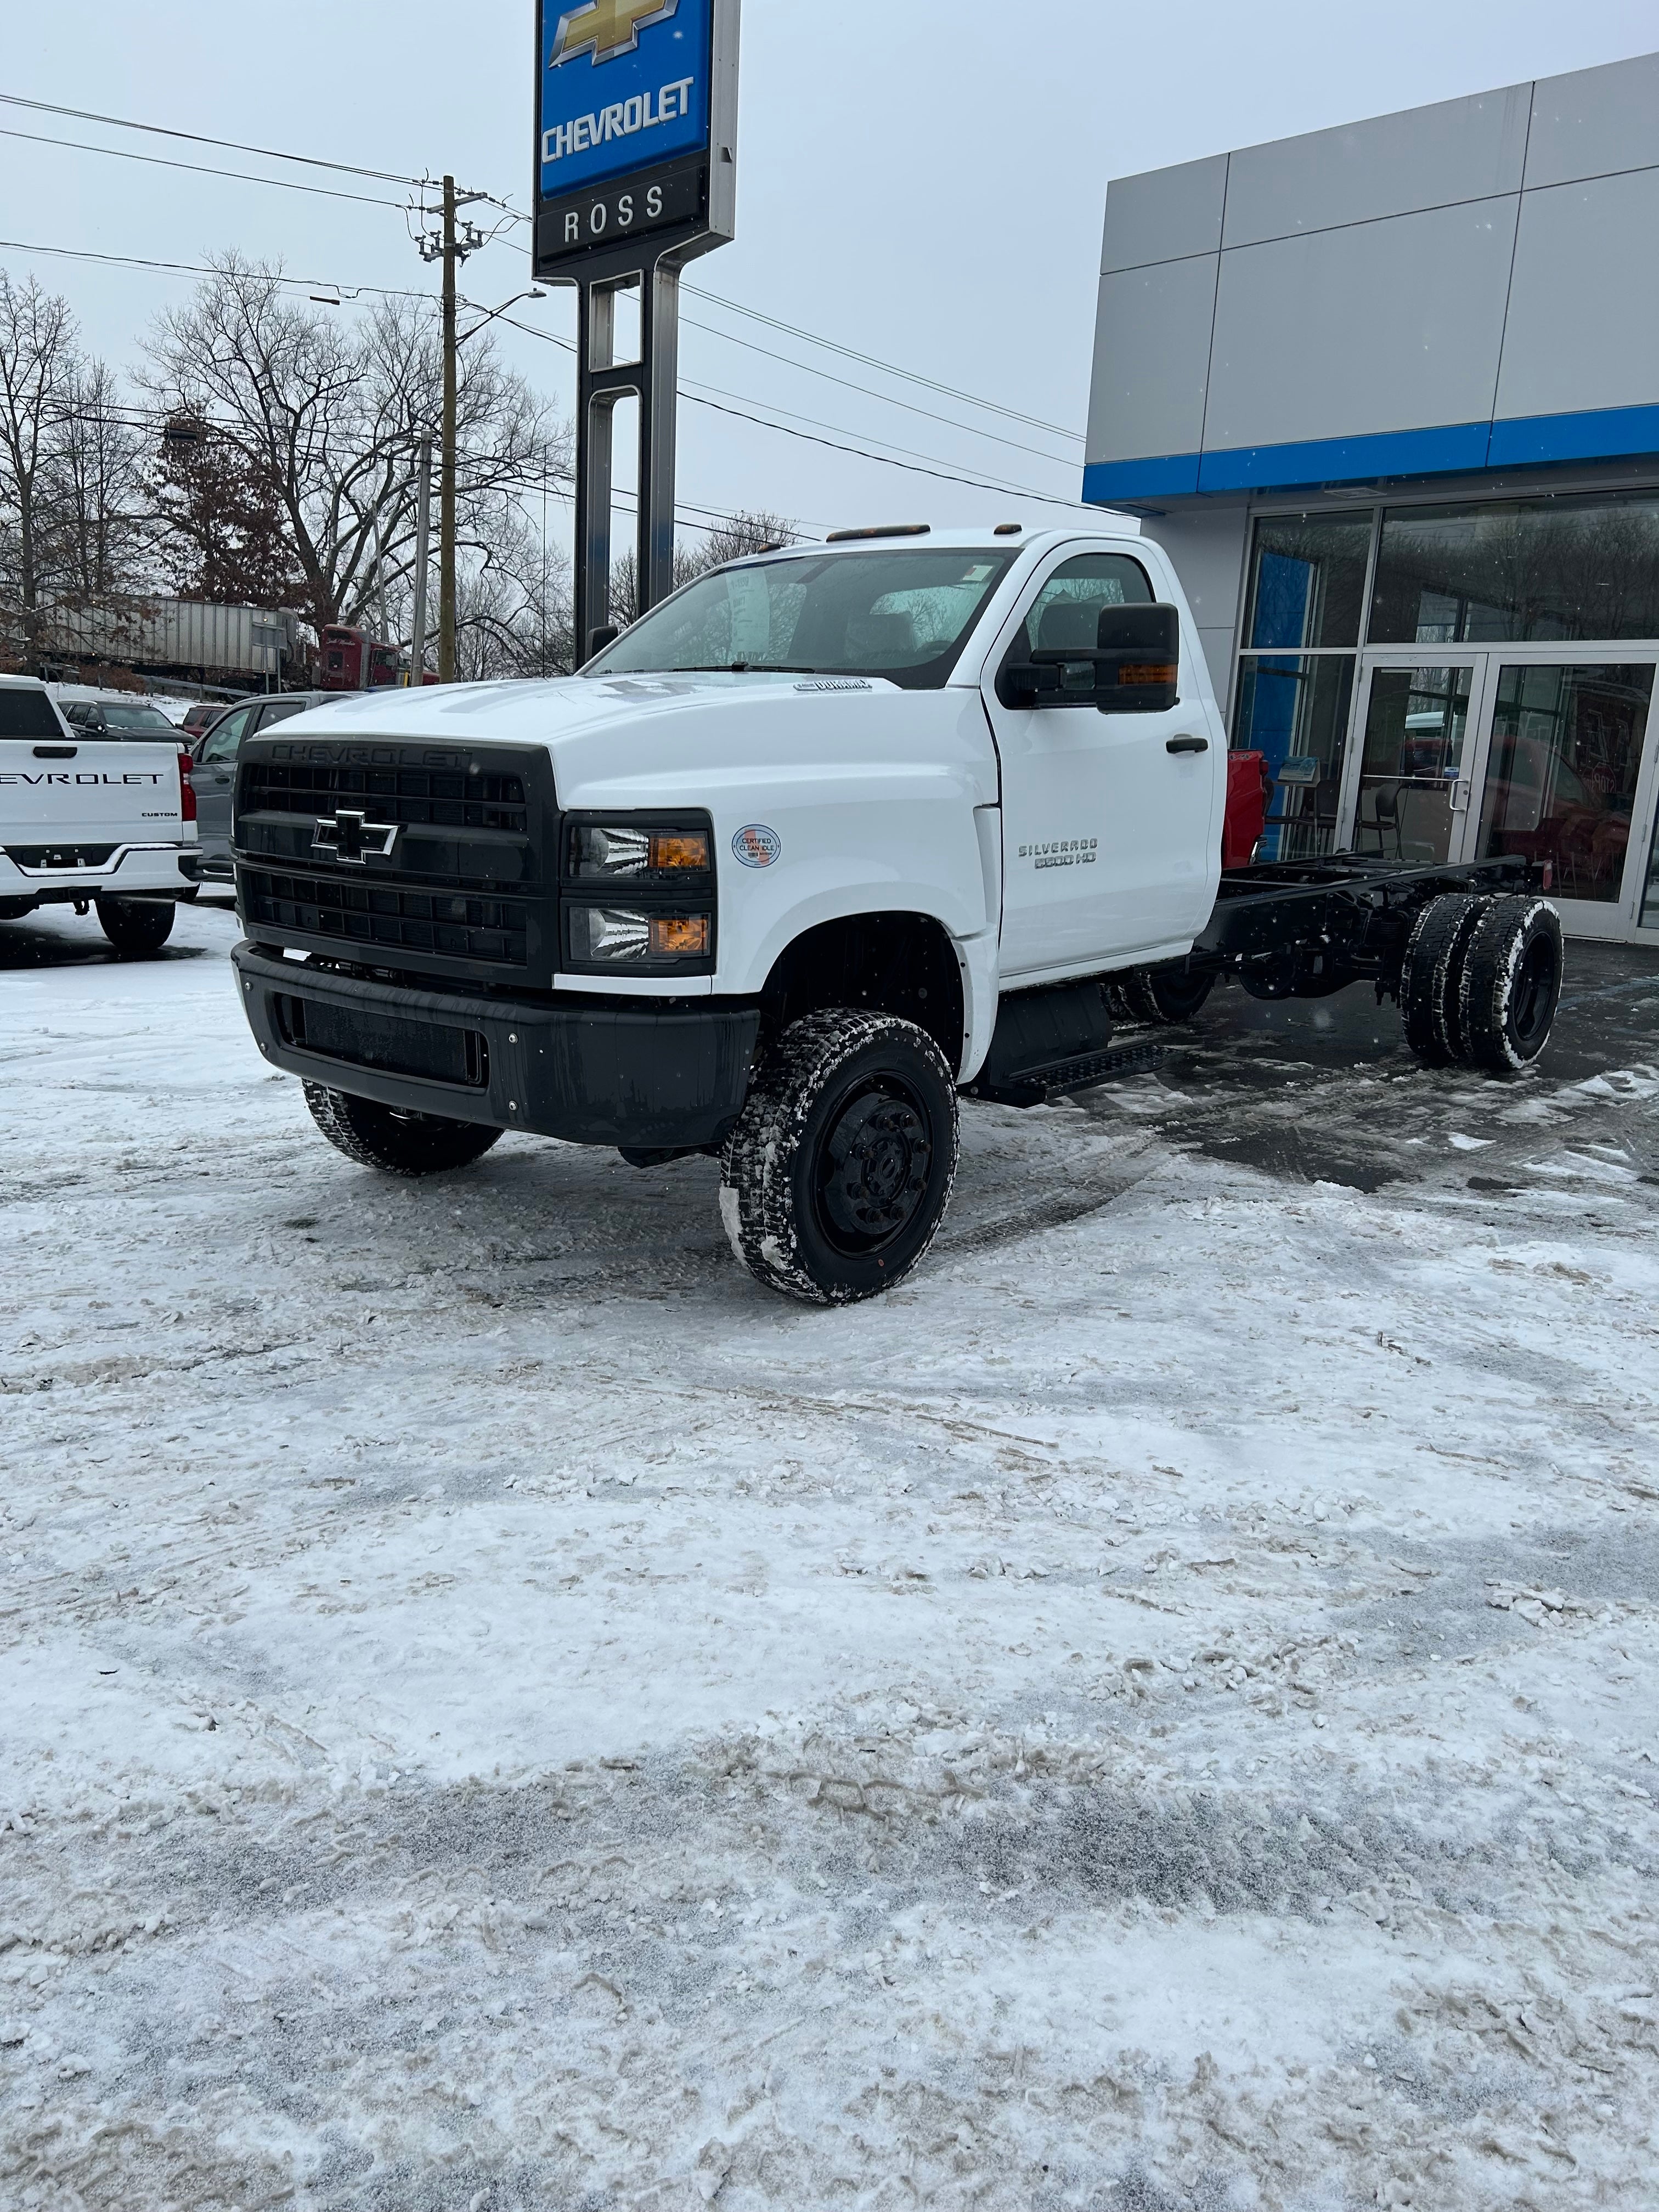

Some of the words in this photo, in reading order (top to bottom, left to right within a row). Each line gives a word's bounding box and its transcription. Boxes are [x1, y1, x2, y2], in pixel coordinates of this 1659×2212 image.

[542, 76, 693, 163] CHEVROLET
[565, 186, 663, 243] ROSS
[272, 745, 473, 768] CHEVROLET
[1019, 838, 1098, 857] SILVERADO
